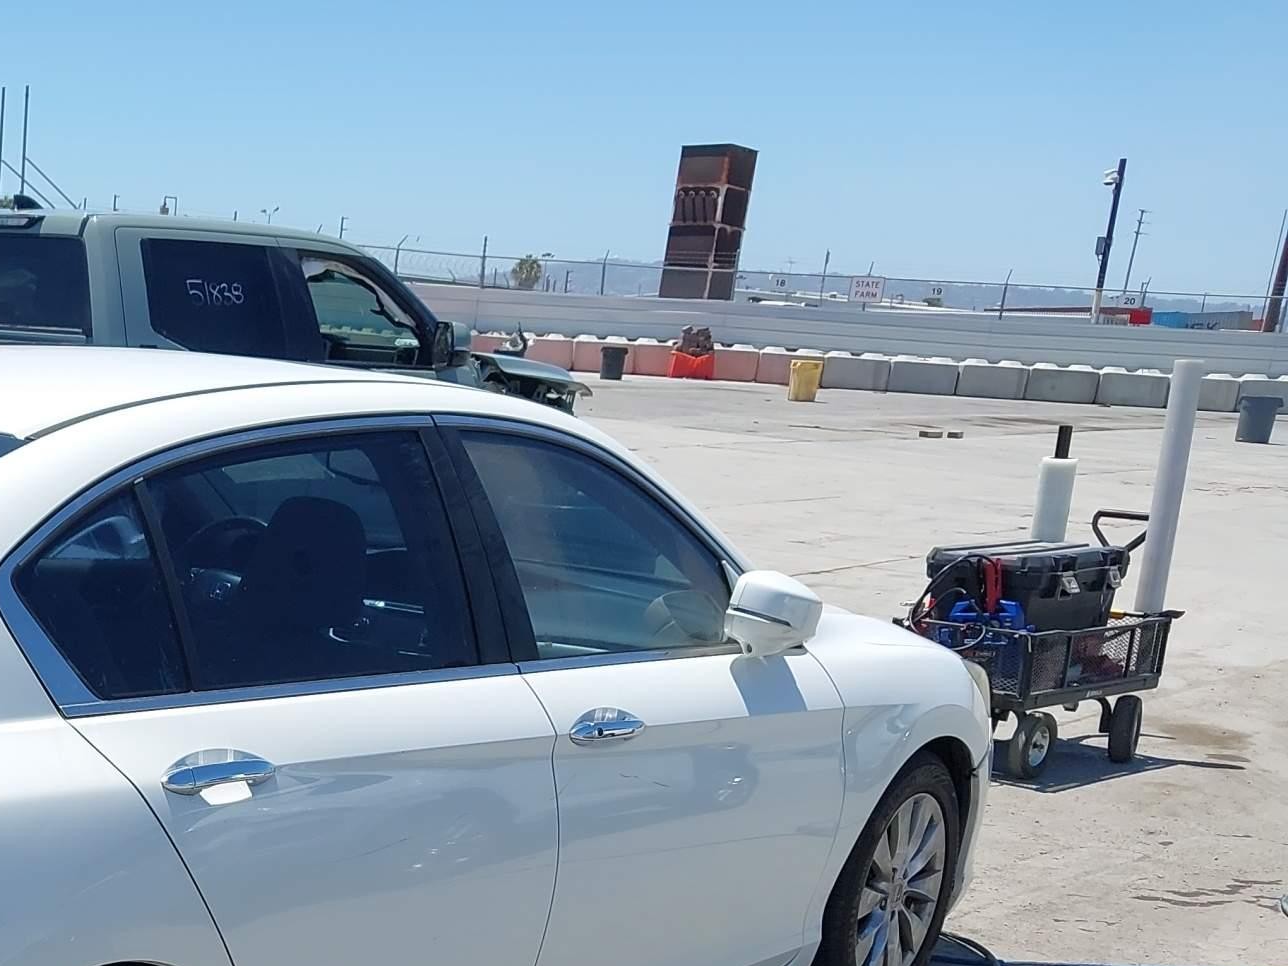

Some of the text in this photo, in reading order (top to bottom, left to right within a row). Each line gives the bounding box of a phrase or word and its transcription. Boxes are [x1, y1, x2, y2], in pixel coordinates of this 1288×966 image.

[775, 279, 787, 288] 18
[855, 280, 881, 289] STATE
[186, 279, 244, 305] 51838
[854, 290, 878, 298] FARM
[931, 287, 943, 296] 19
[1123, 297, 1136, 305] 20
